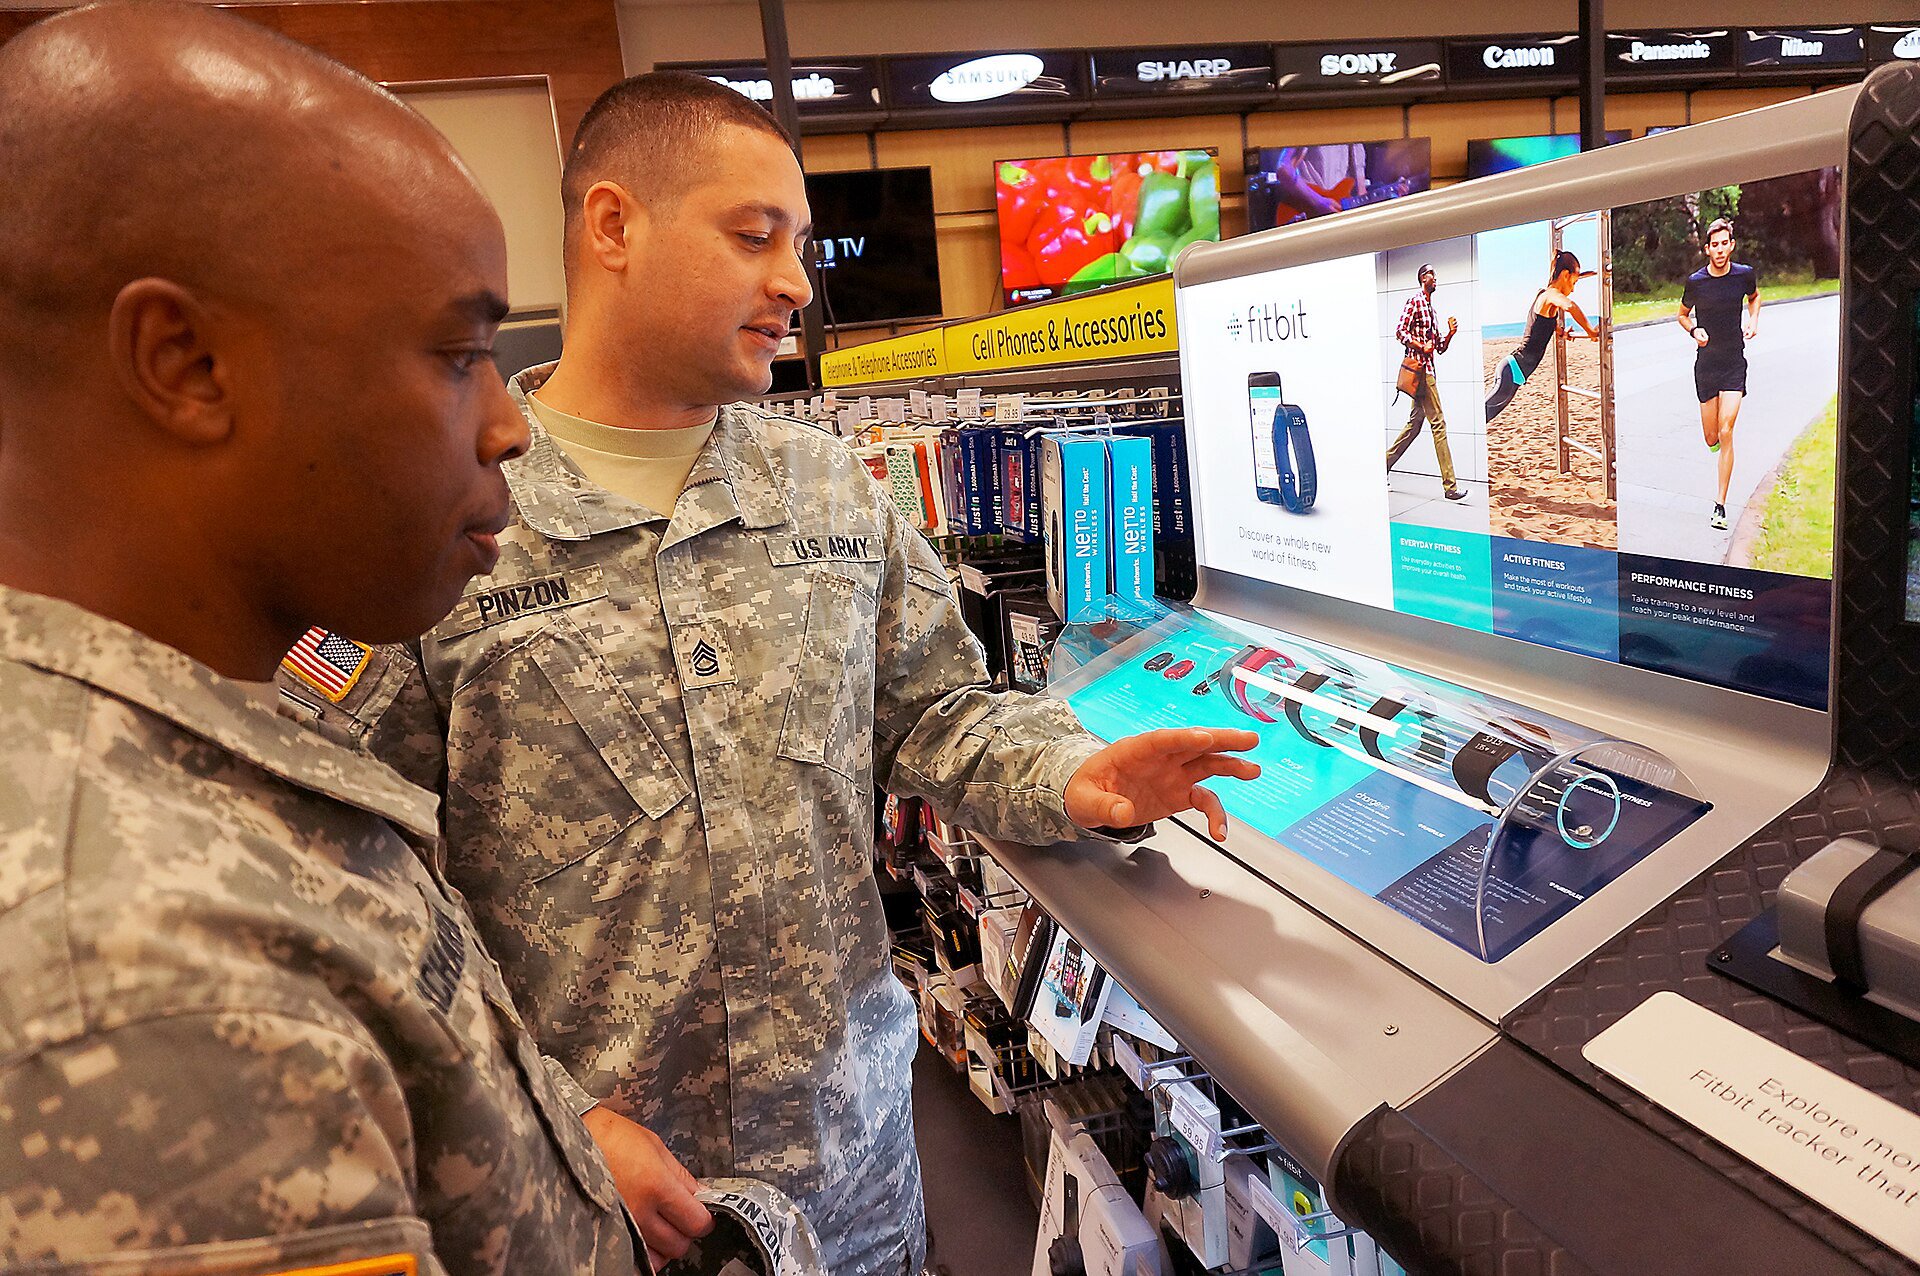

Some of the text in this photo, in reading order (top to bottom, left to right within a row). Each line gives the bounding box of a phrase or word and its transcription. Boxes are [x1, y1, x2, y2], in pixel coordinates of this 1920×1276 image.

[1482, 45, 1555, 69] Canon
[1631, 40, 1710, 61] Panasonic
[1781, 38, 1823, 57] Nikon
[1137, 58, 1232, 82] SHARP
[1320, 53, 1397, 75] SONY
[946, 68, 1030, 85] SAMSUNG
[838, 236, 865, 258] TV
[972, 301, 1167, 361] Cell Phones & Accessories
[1248, 299, 1308, 343] fitbit
[852, 356, 858, 376] &
[857, 351, 892, 381] Telephone
[891, 342, 938, 371] Accessories
[792, 536, 870, 560] U.S. ARMY
[1239, 526, 1332, 554] Discover a whole new
[1400, 537, 1461, 555] EVERYDAY FITNESS
[1251, 548, 1319, 571] world of fitness.
[1411, 556, 1432, 568] everyday
[1433, 560, 1455, 571] activities
[1455, 564, 1462, 572] to
[1503, 554, 1566, 571] ACTIVE FITNESS
[1401, 564, 1466, 581] improve your overall health
[1504, 572, 1585, 594] Make the most of workouts
[1504, 581, 1593, 605] and track your active lifestyle
[1631, 572, 1754, 600] PERFORMANCE FITNESS
[477, 577, 570, 623] PINZON
[1632, 594, 1650, 605] Take
[1650, 597, 1680, 610] training
[1681, 603, 1690, 611] to
[1698, 607, 1715, 616] new
[1717, 608, 1737, 620] level
[1738, 612, 1755, 623] and
[1631, 605, 1746, 632] reach your peak performance
[1758, 1078, 1858, 1139] Explore
[1182, 1122, 1204, 1151] 59.95
[1689, 1069, 1920, 1209] Fitbit tracker that
[1283, 1157, 1303, 1179] fitbit
[719, 1192, 784, 1271] PINZON
